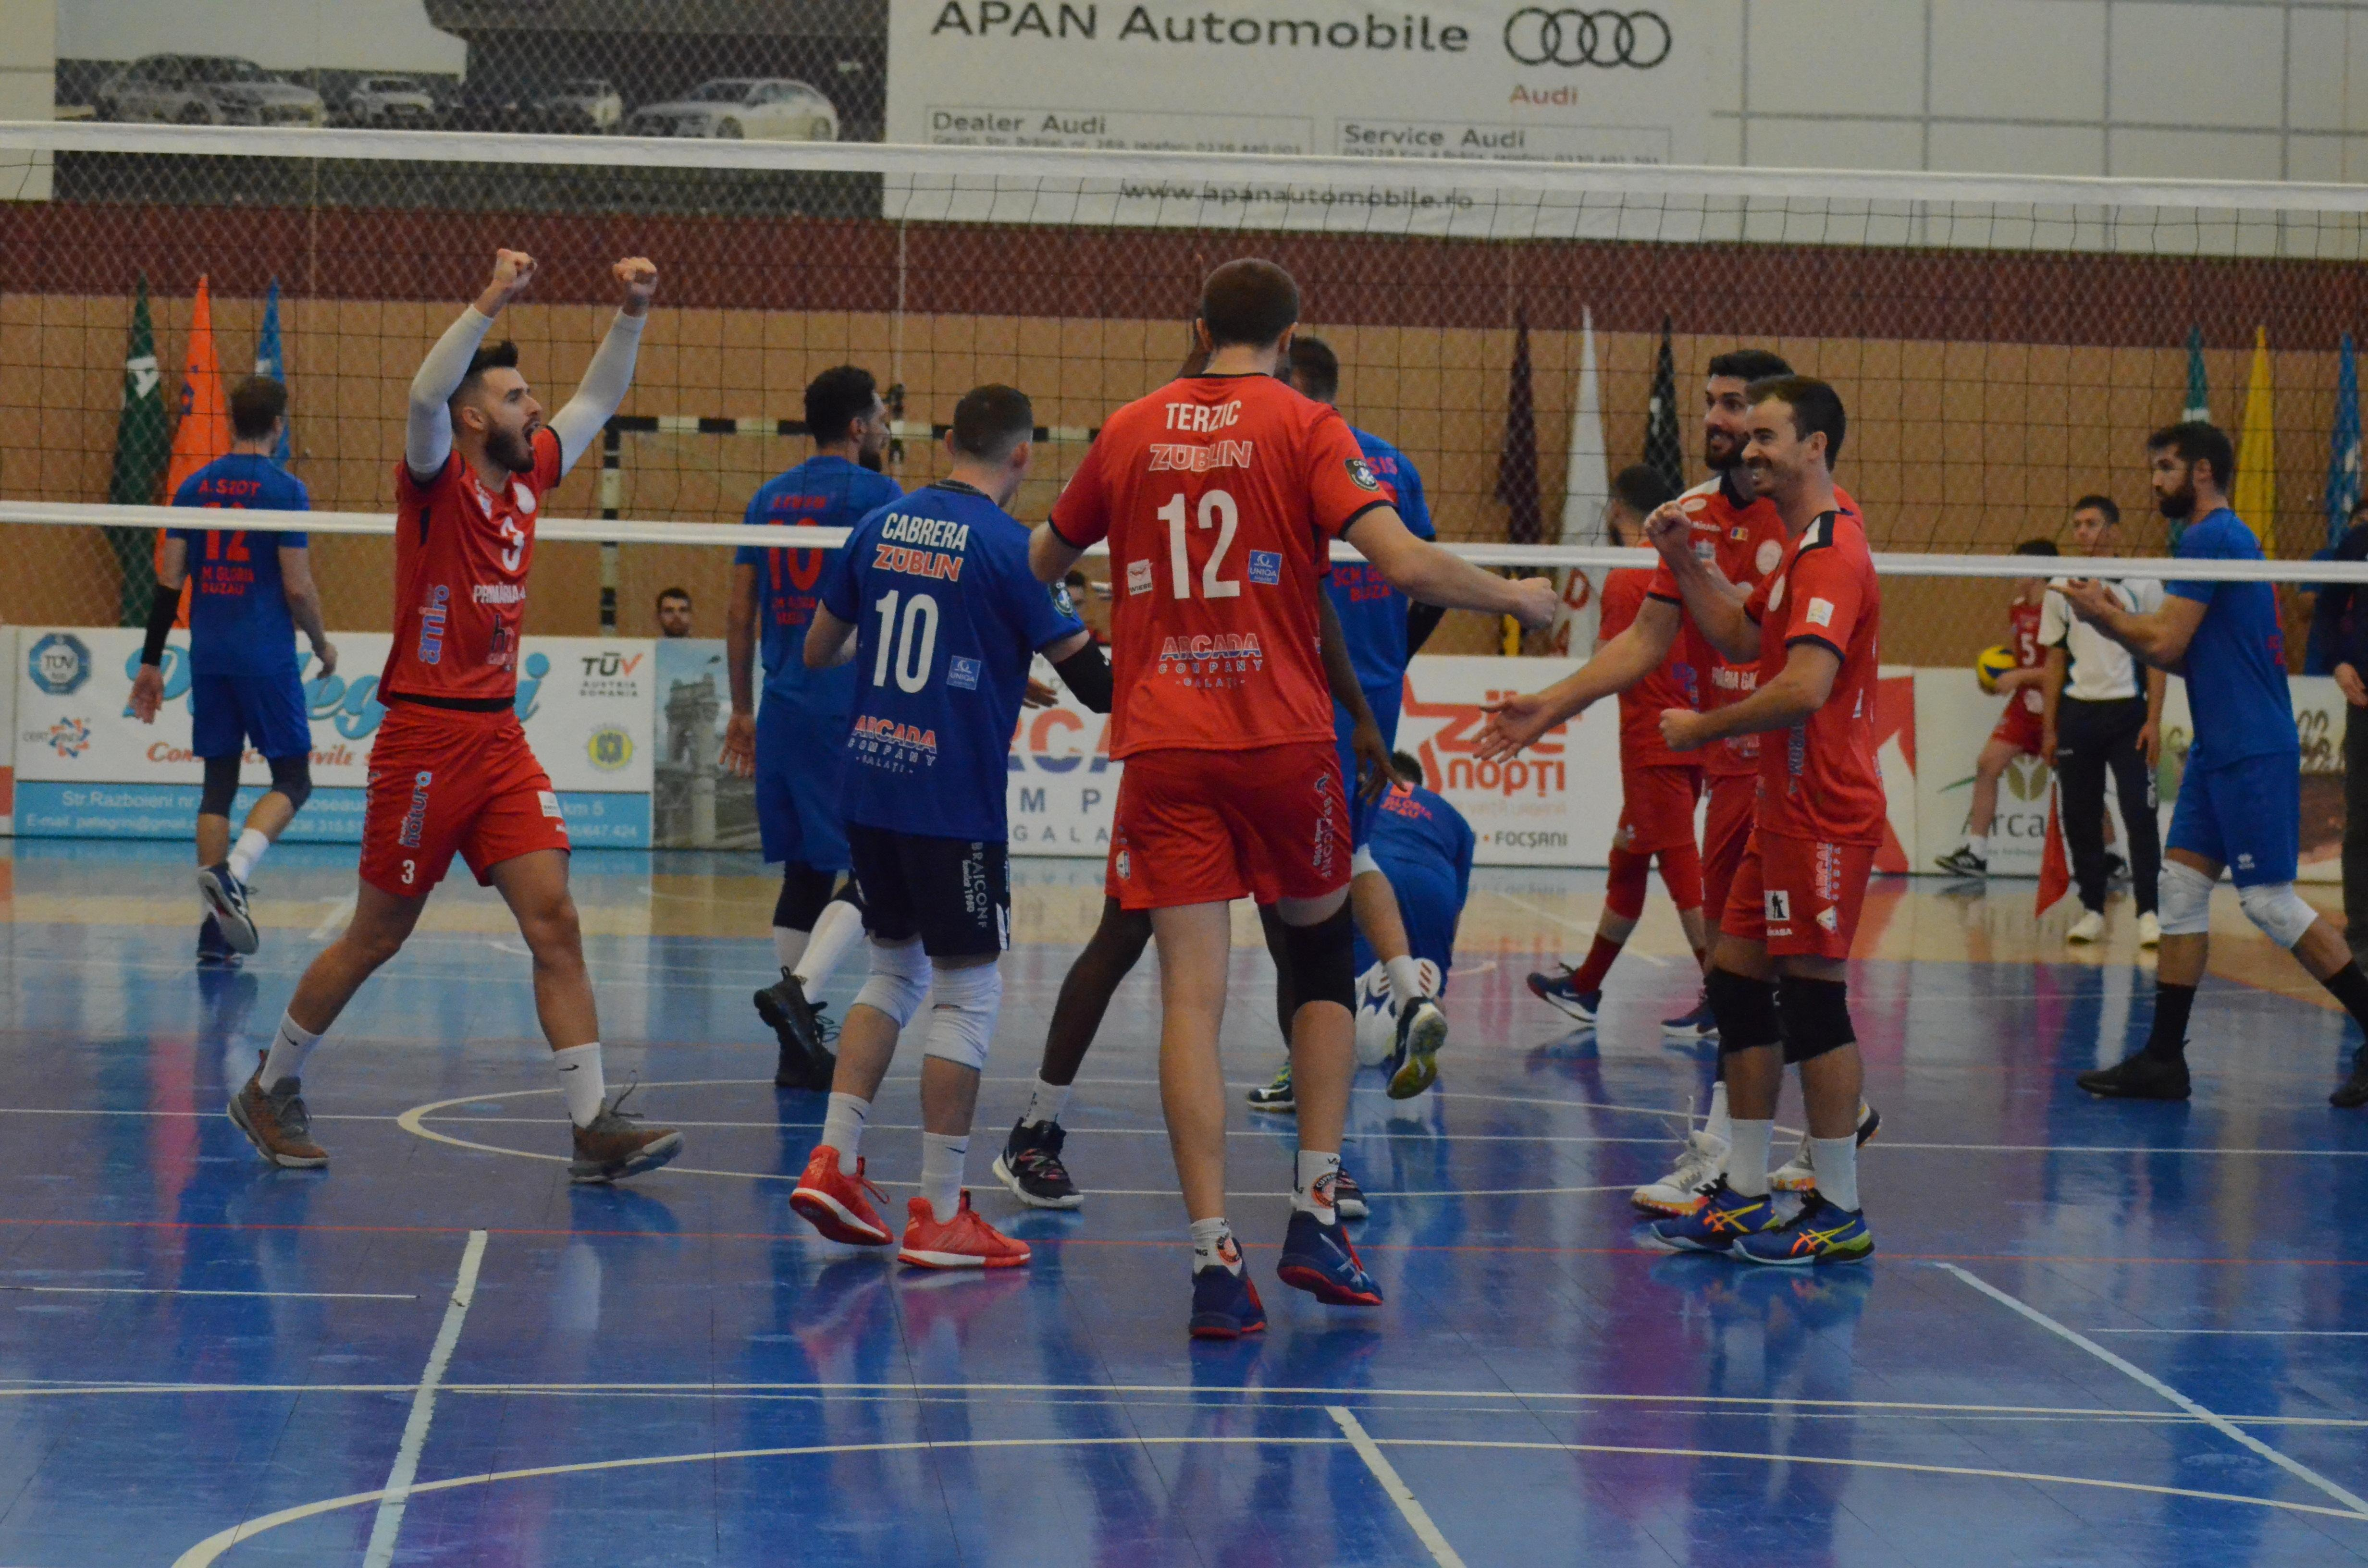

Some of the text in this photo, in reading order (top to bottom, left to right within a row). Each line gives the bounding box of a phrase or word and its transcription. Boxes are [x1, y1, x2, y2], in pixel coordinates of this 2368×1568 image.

[931, 0, 1468, 51] APAN Automobile
[1509, 84, 1579, 105] Audi
[933, 111, 1106, 135] Dealer Audi
[1344, 123, 1526, 149] Service Audi
[881, 513, 969, 551] CABRERA
[1157, 490, 1241, 599] 12
[873, 589, 939, 694] 10
[2021, 634, 2036, 665] 5
[1158, 659, 1263, 674] COMPANY
[847, 737, 936, 766] COMPANY
[1013, 823, 1109, 843] GALA
[401, 859, 415, 884] 3
[971, 841, 988, 928] BRAICONF
